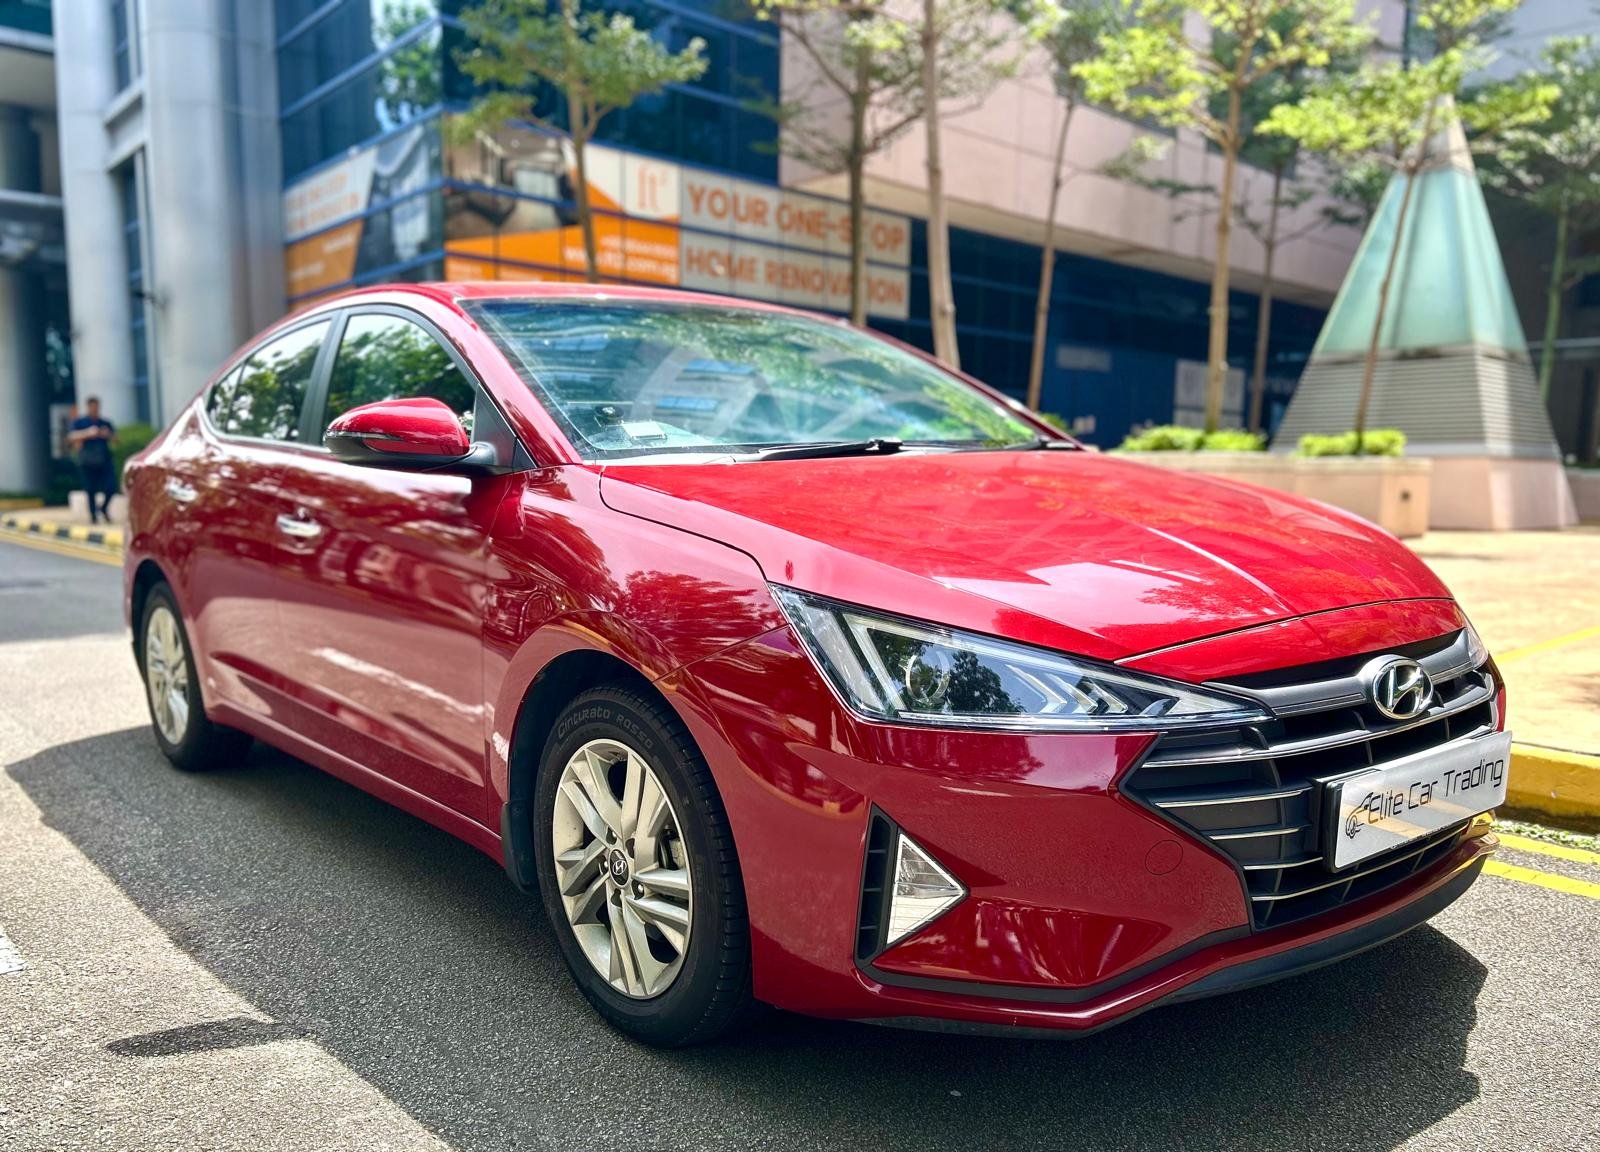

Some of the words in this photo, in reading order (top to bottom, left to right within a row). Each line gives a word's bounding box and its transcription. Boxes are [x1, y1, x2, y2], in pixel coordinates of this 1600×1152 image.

[687, 184, 769, 227] YOUR
[776, 202, 904, 252] ONE-SOP
[686, 245, 757, 284] HOME
[764, 259, 904, 304] RENOVAION
[1368, 790, 1404, 825] Elite
[1408, 780, 1438, 810] Car
[1443, 758, 1504, 797] Trading
